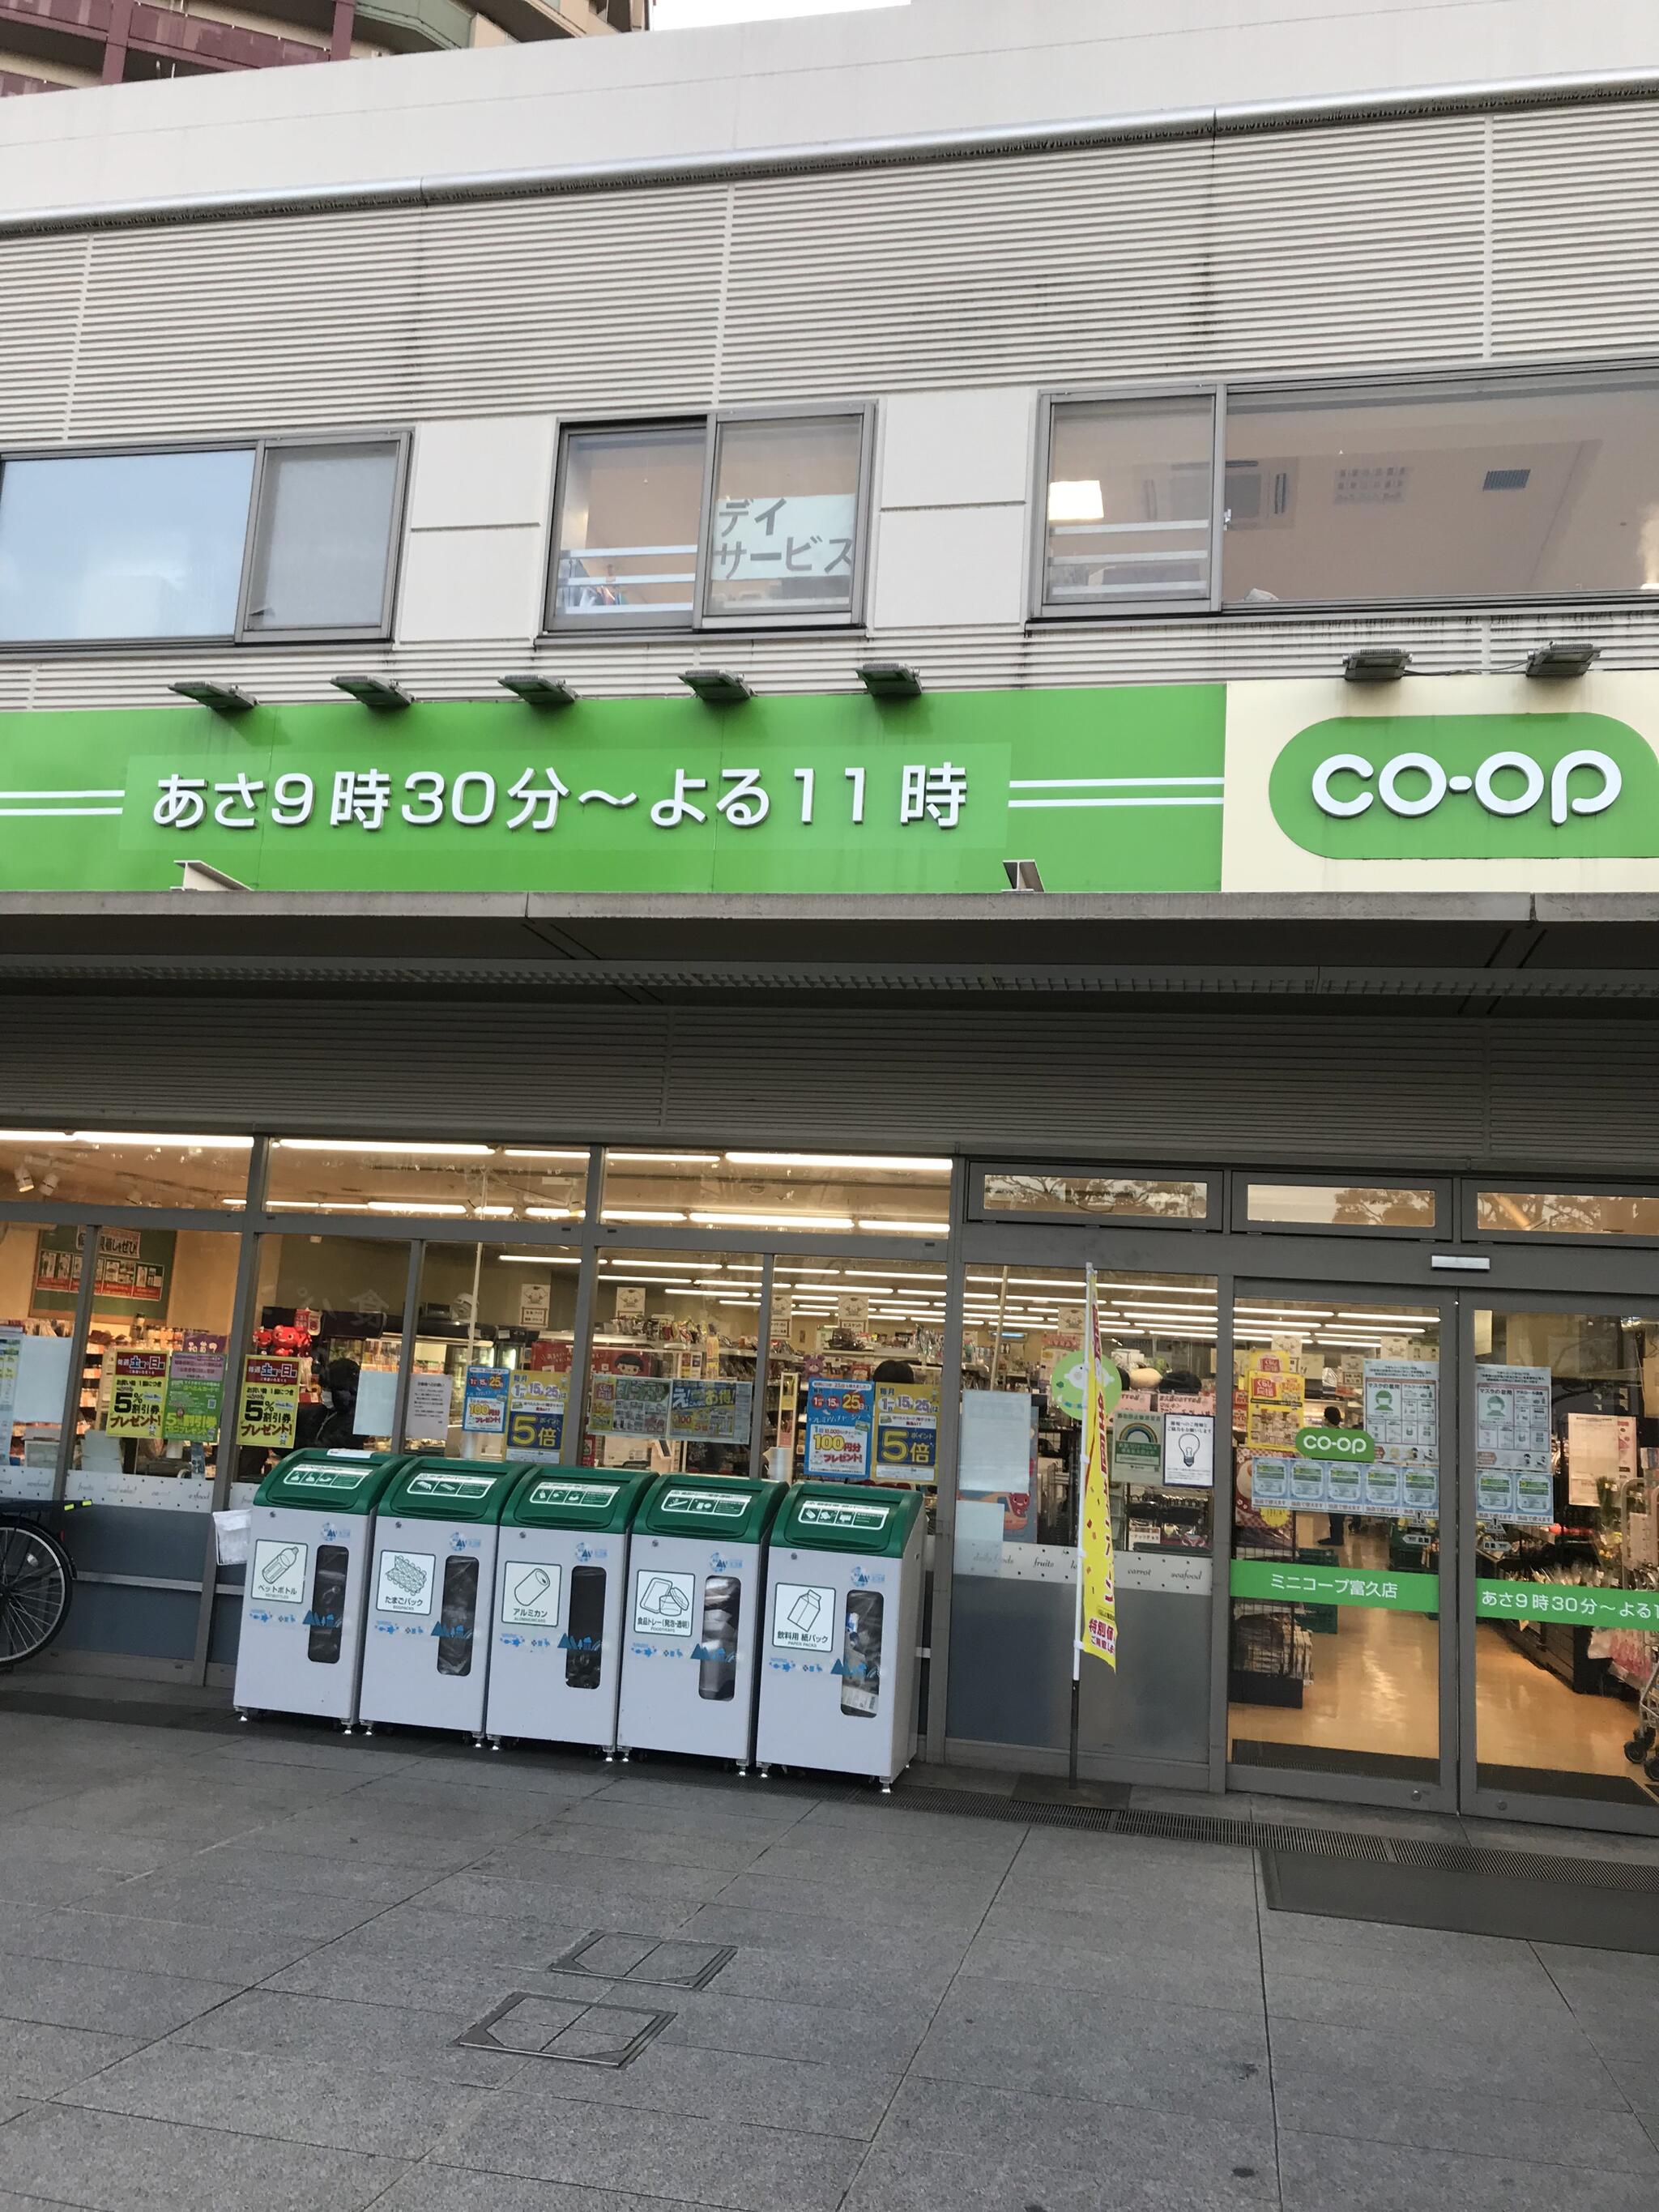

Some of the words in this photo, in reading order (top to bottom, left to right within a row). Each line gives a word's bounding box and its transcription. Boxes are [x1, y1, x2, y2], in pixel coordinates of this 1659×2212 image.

[719, 497, 787, 538] デイ
[713, 535, 852, 579] サービス
[1033, 1557, 1054, 1568] fruits
[1128, 1568, 1151, 1577] carrot
[1171, 1570, 1202, 1580] seafood
[258, 1585, 297, 1595] ペットボトル
[1271, 1574, 1398, 1599] ミニコープ富久店
[385, 1596, 423, 1606] たまごパック
[513, 1608, 548, 1618] アルミカン
[777, 1630, 799, 1641] 飲料用
[801, 1634, 828, 1643] 紙パック
